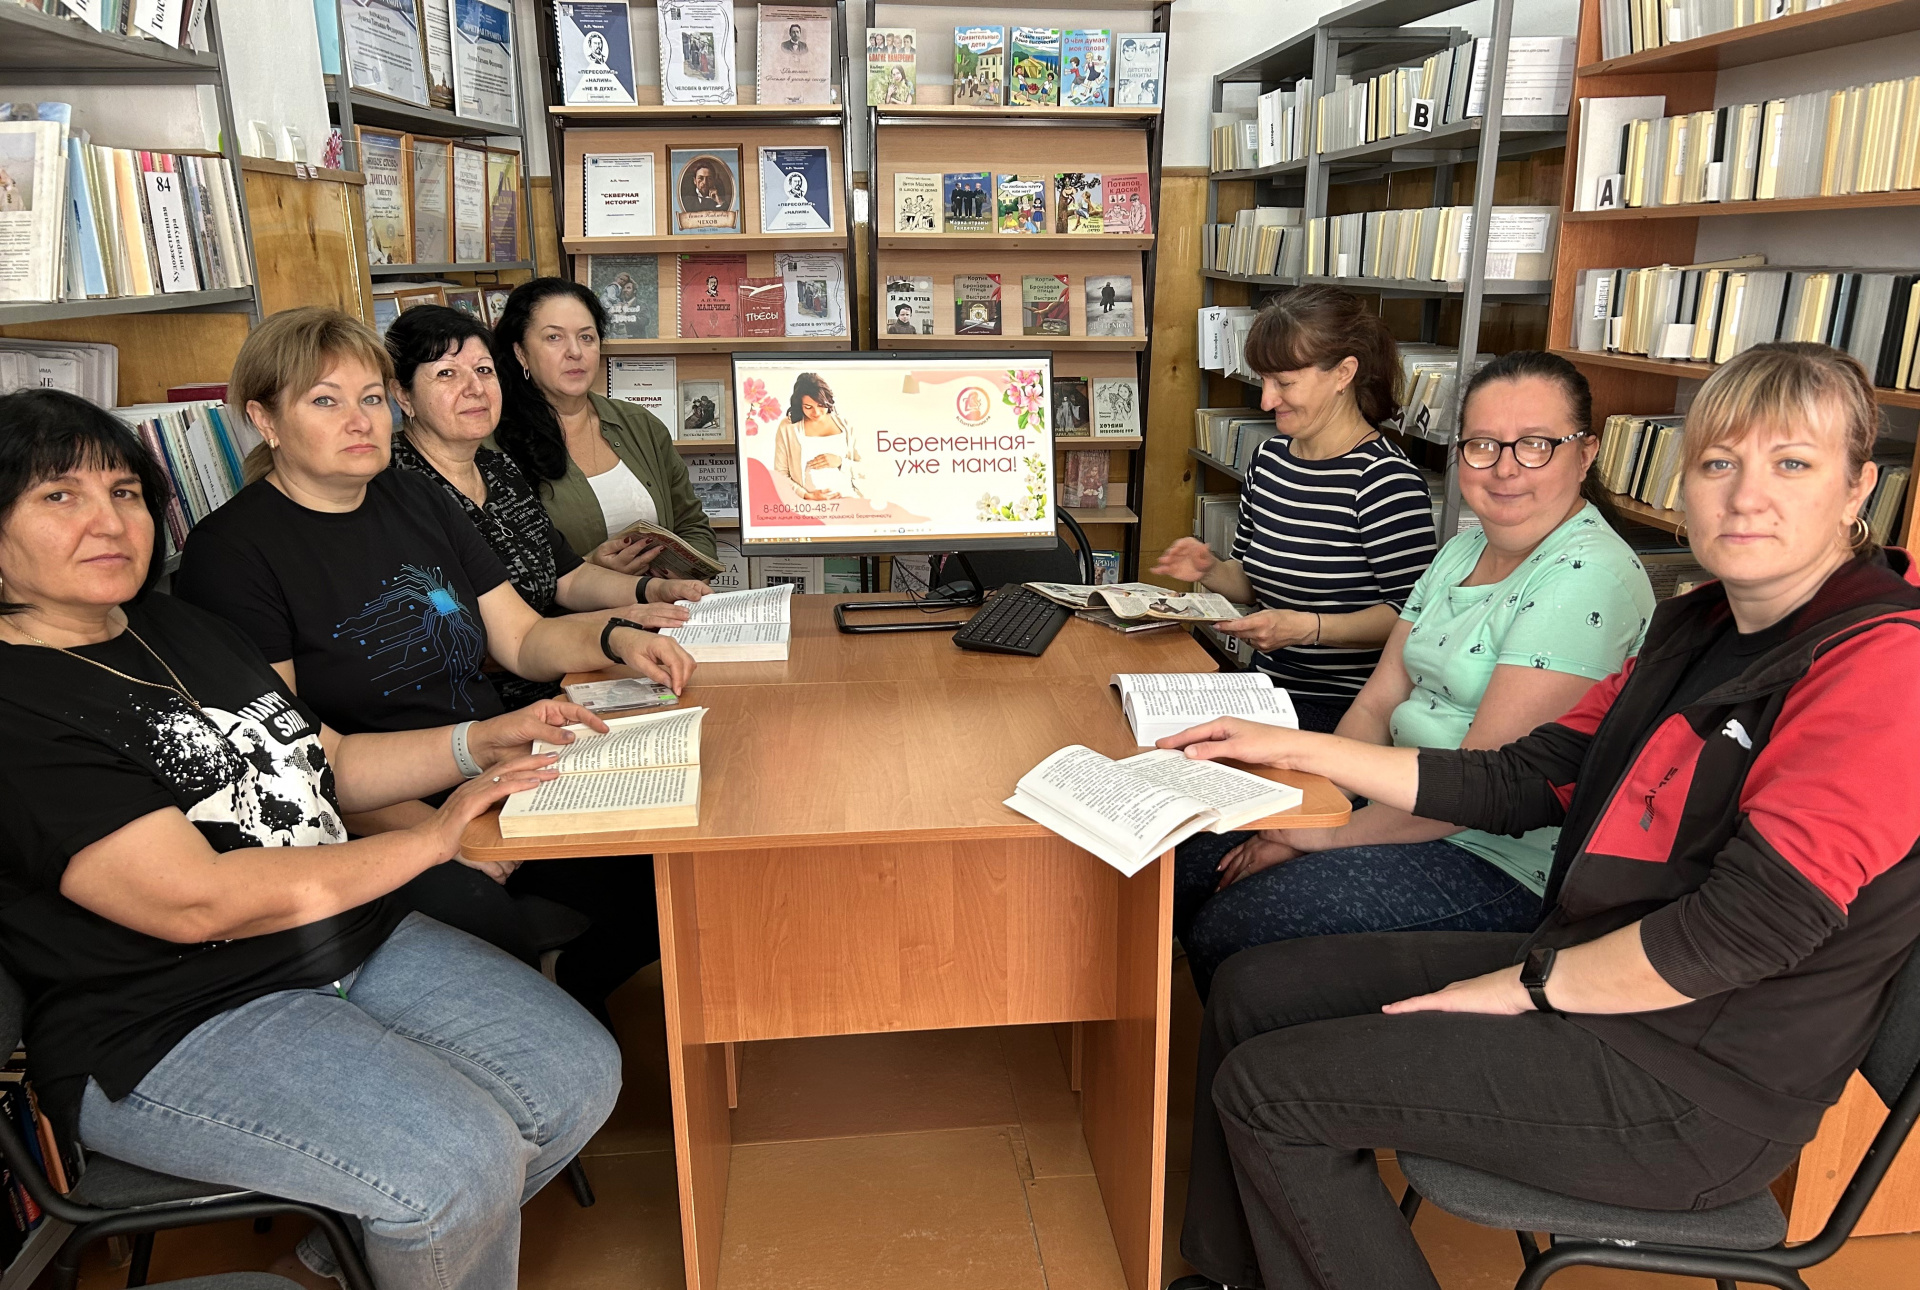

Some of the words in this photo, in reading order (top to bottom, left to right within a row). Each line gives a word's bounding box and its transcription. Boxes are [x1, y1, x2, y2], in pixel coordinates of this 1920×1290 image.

[958, 34, 999, 42] Удивительные
[1085, 37, 1108, 45] думает
[1413, 103, 1429, 128] В
[156, 176, 171, 192] 84
[369, 173, 398, 186] ДИПЛОМ
[1599, 179, 1614, 207] А
[162, 206, 179, 283] Художественная
[172, 218, 185, 271] литература
[745, 312, 779, 321] ПЬЕСЫ
[1210, 313, 1220, 321] 87
[877, 430, 1035, 456] Беременная-
[895, 457, 940, 478] уже
[952, 455, 1018, 473] мама!
[763, 503, 840, 513] 8-800-100-48-77
[1228, 636, 1237, 651] Б
